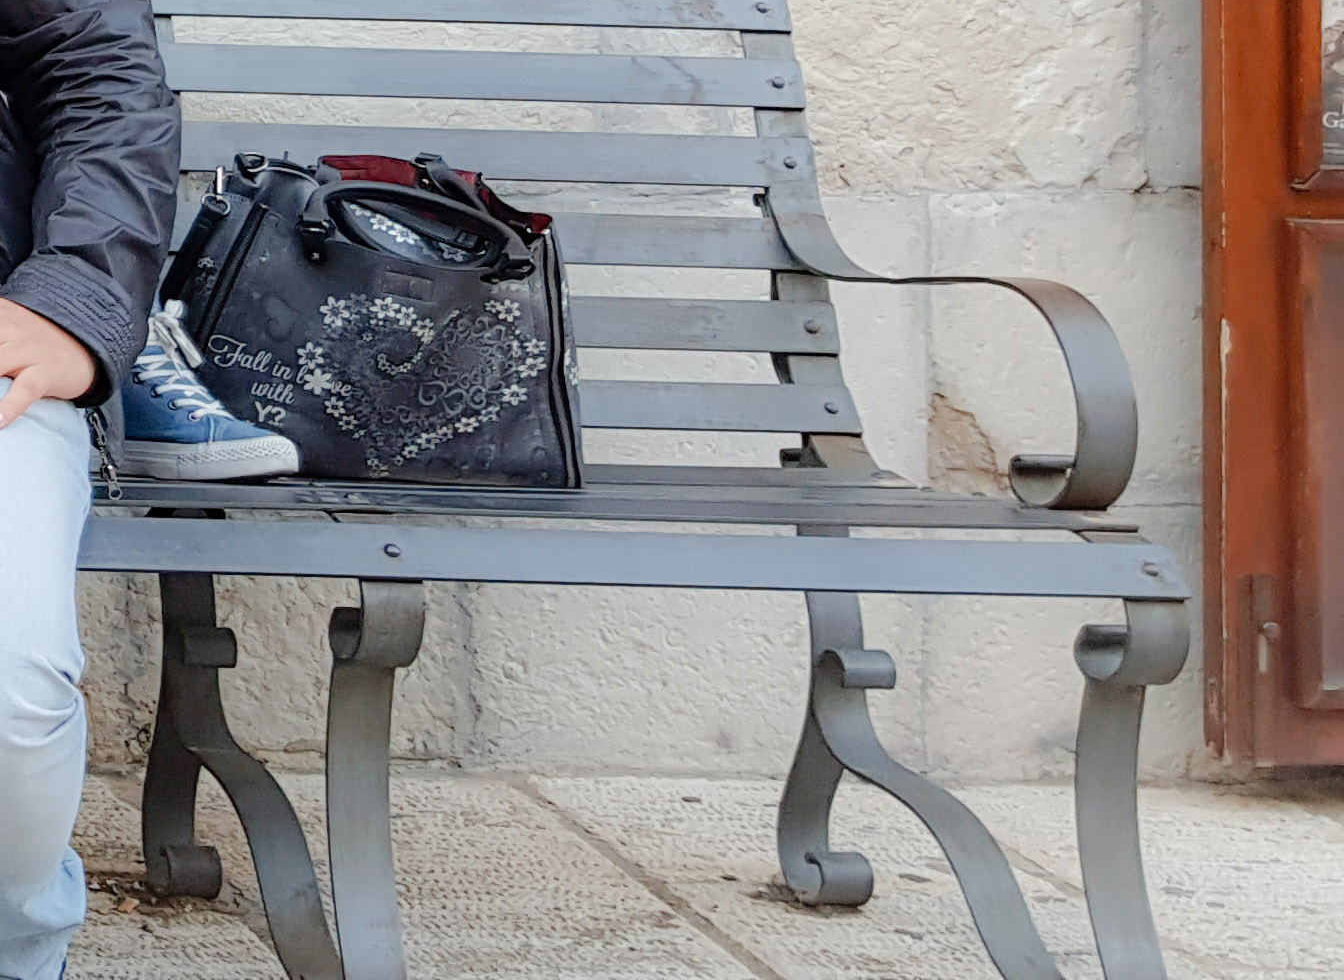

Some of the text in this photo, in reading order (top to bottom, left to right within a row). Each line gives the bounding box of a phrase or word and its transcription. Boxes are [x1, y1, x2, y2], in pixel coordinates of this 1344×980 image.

[208, 334, 353, 397] Fall in lve
[251, 381, 295, 405] with
